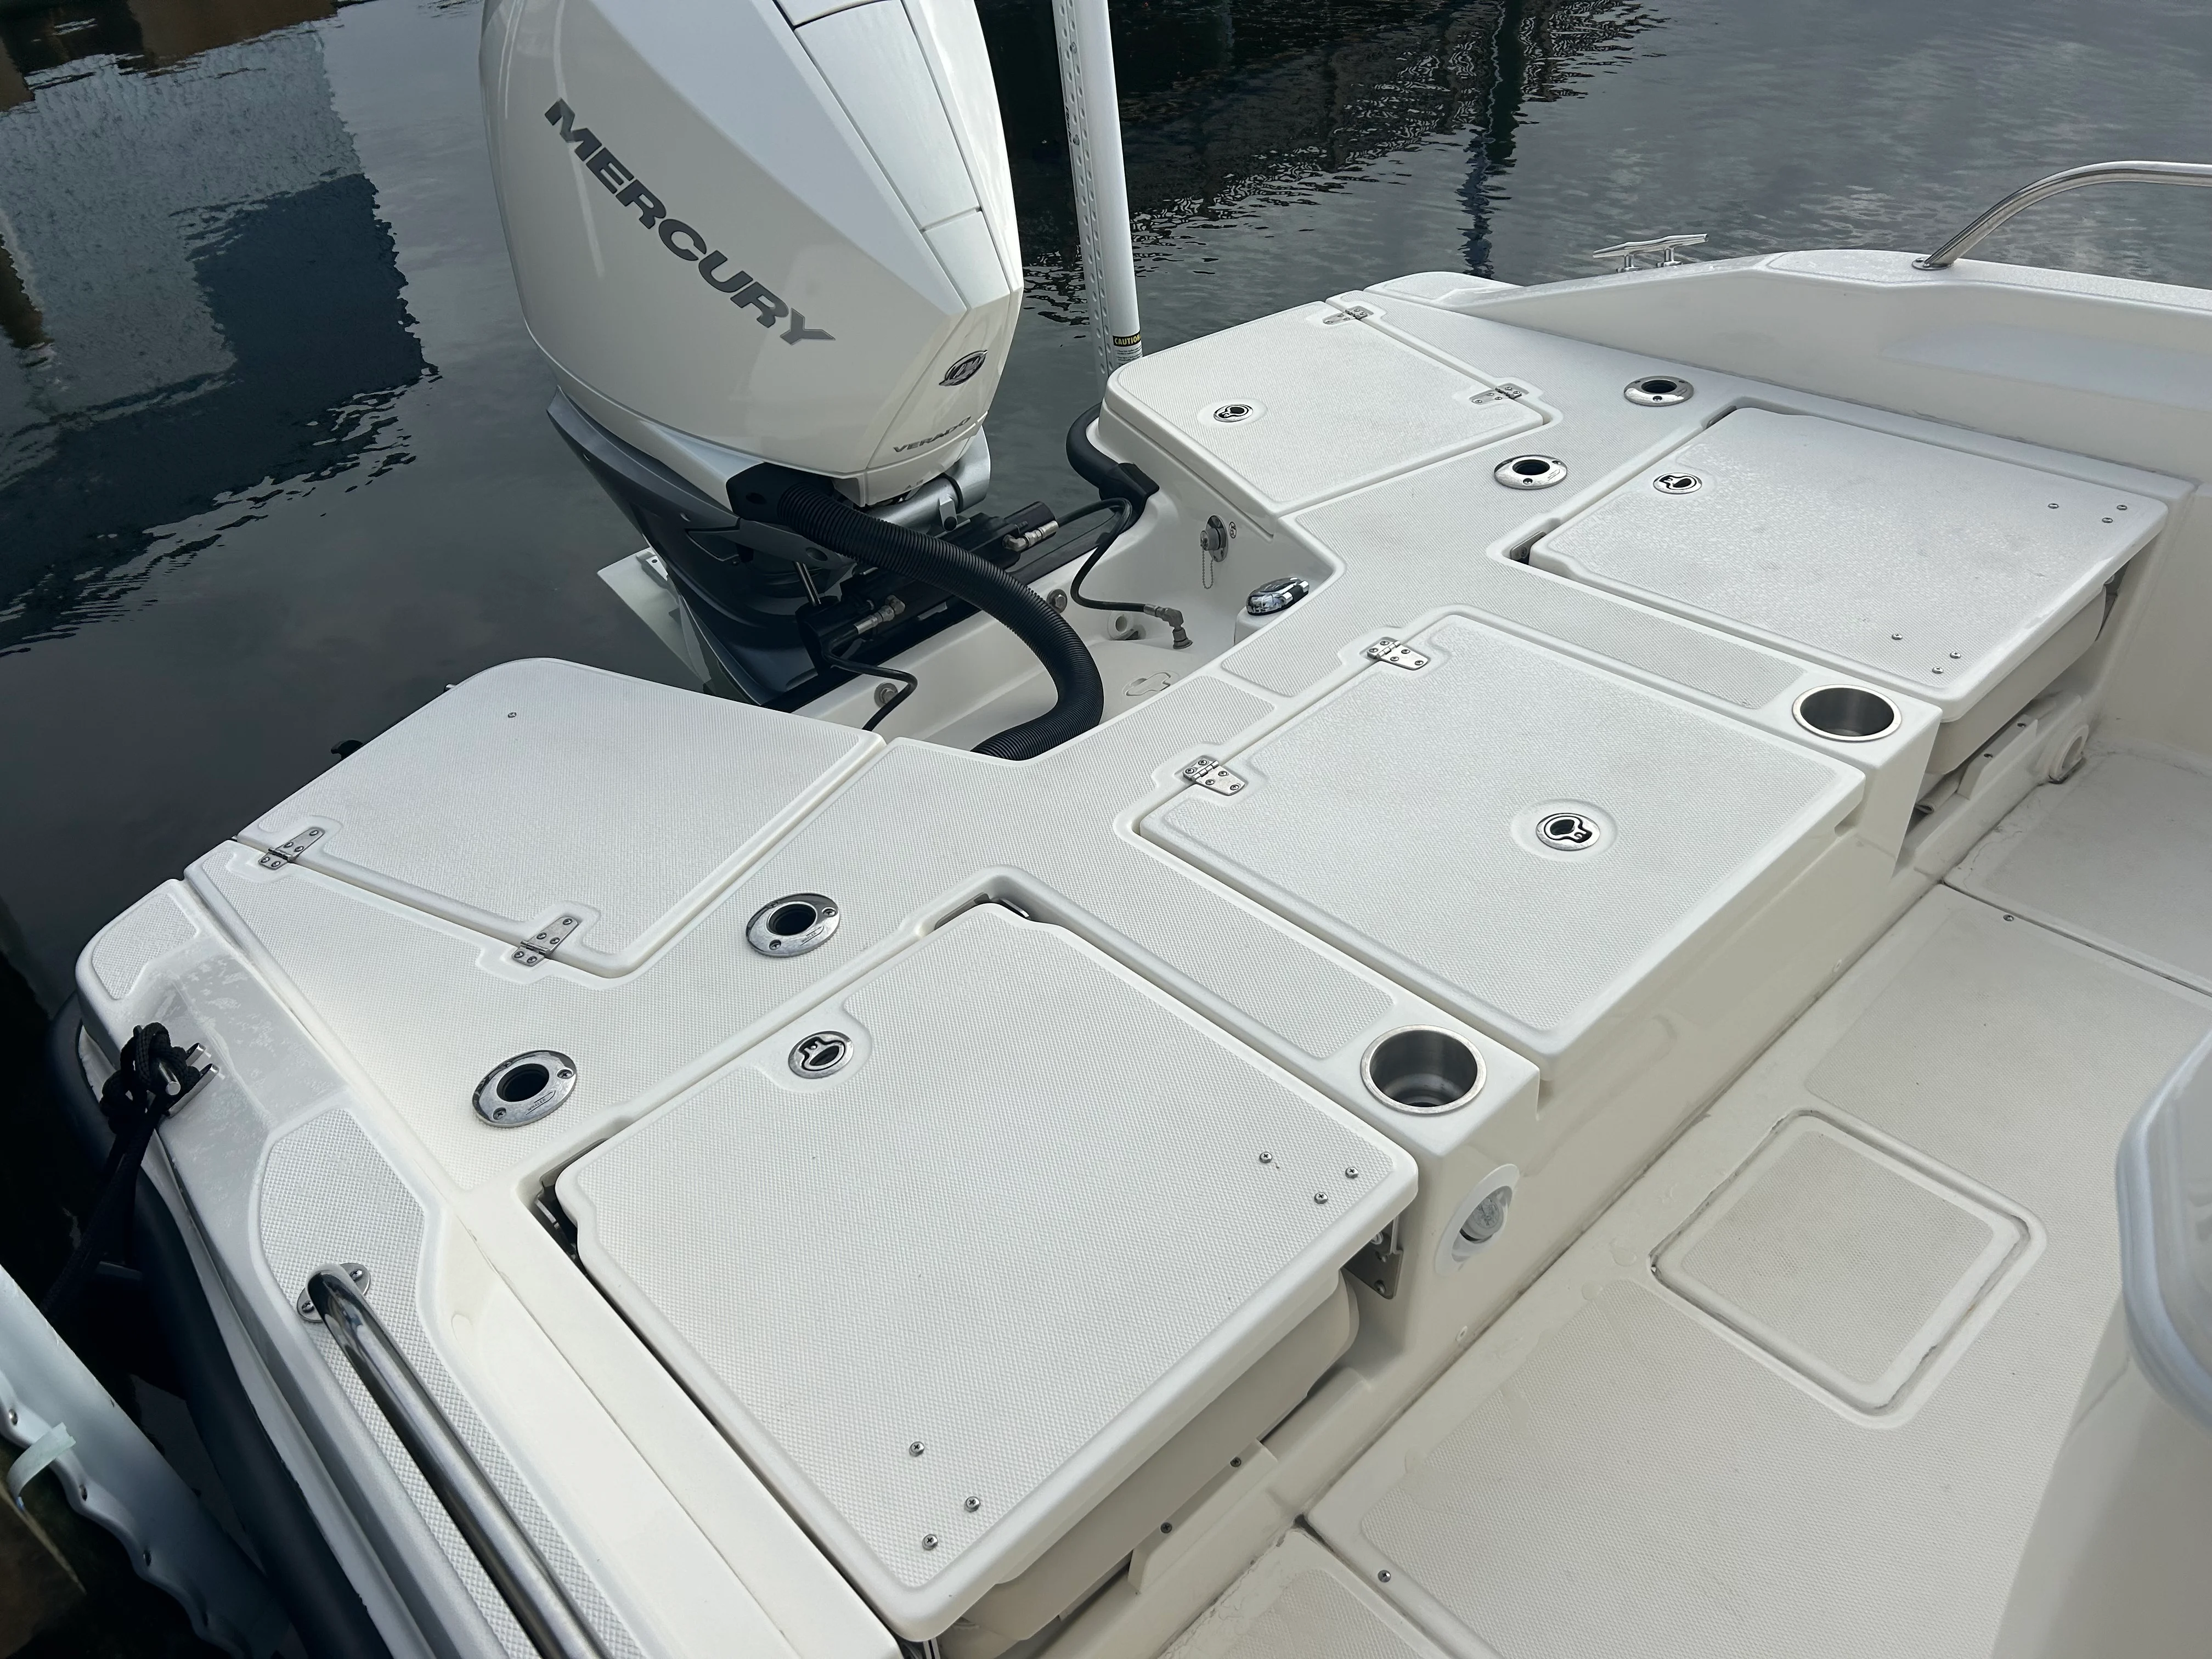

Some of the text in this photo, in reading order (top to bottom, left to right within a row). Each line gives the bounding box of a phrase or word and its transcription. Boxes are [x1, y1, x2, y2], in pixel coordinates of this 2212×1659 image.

[545, 98, 836, 345] MERCURY
[1115, 334, 1140, 345] CAUTION
[893, 415, 971, 453] VERADO
[527, 1098, 546, 1111] WHALER
